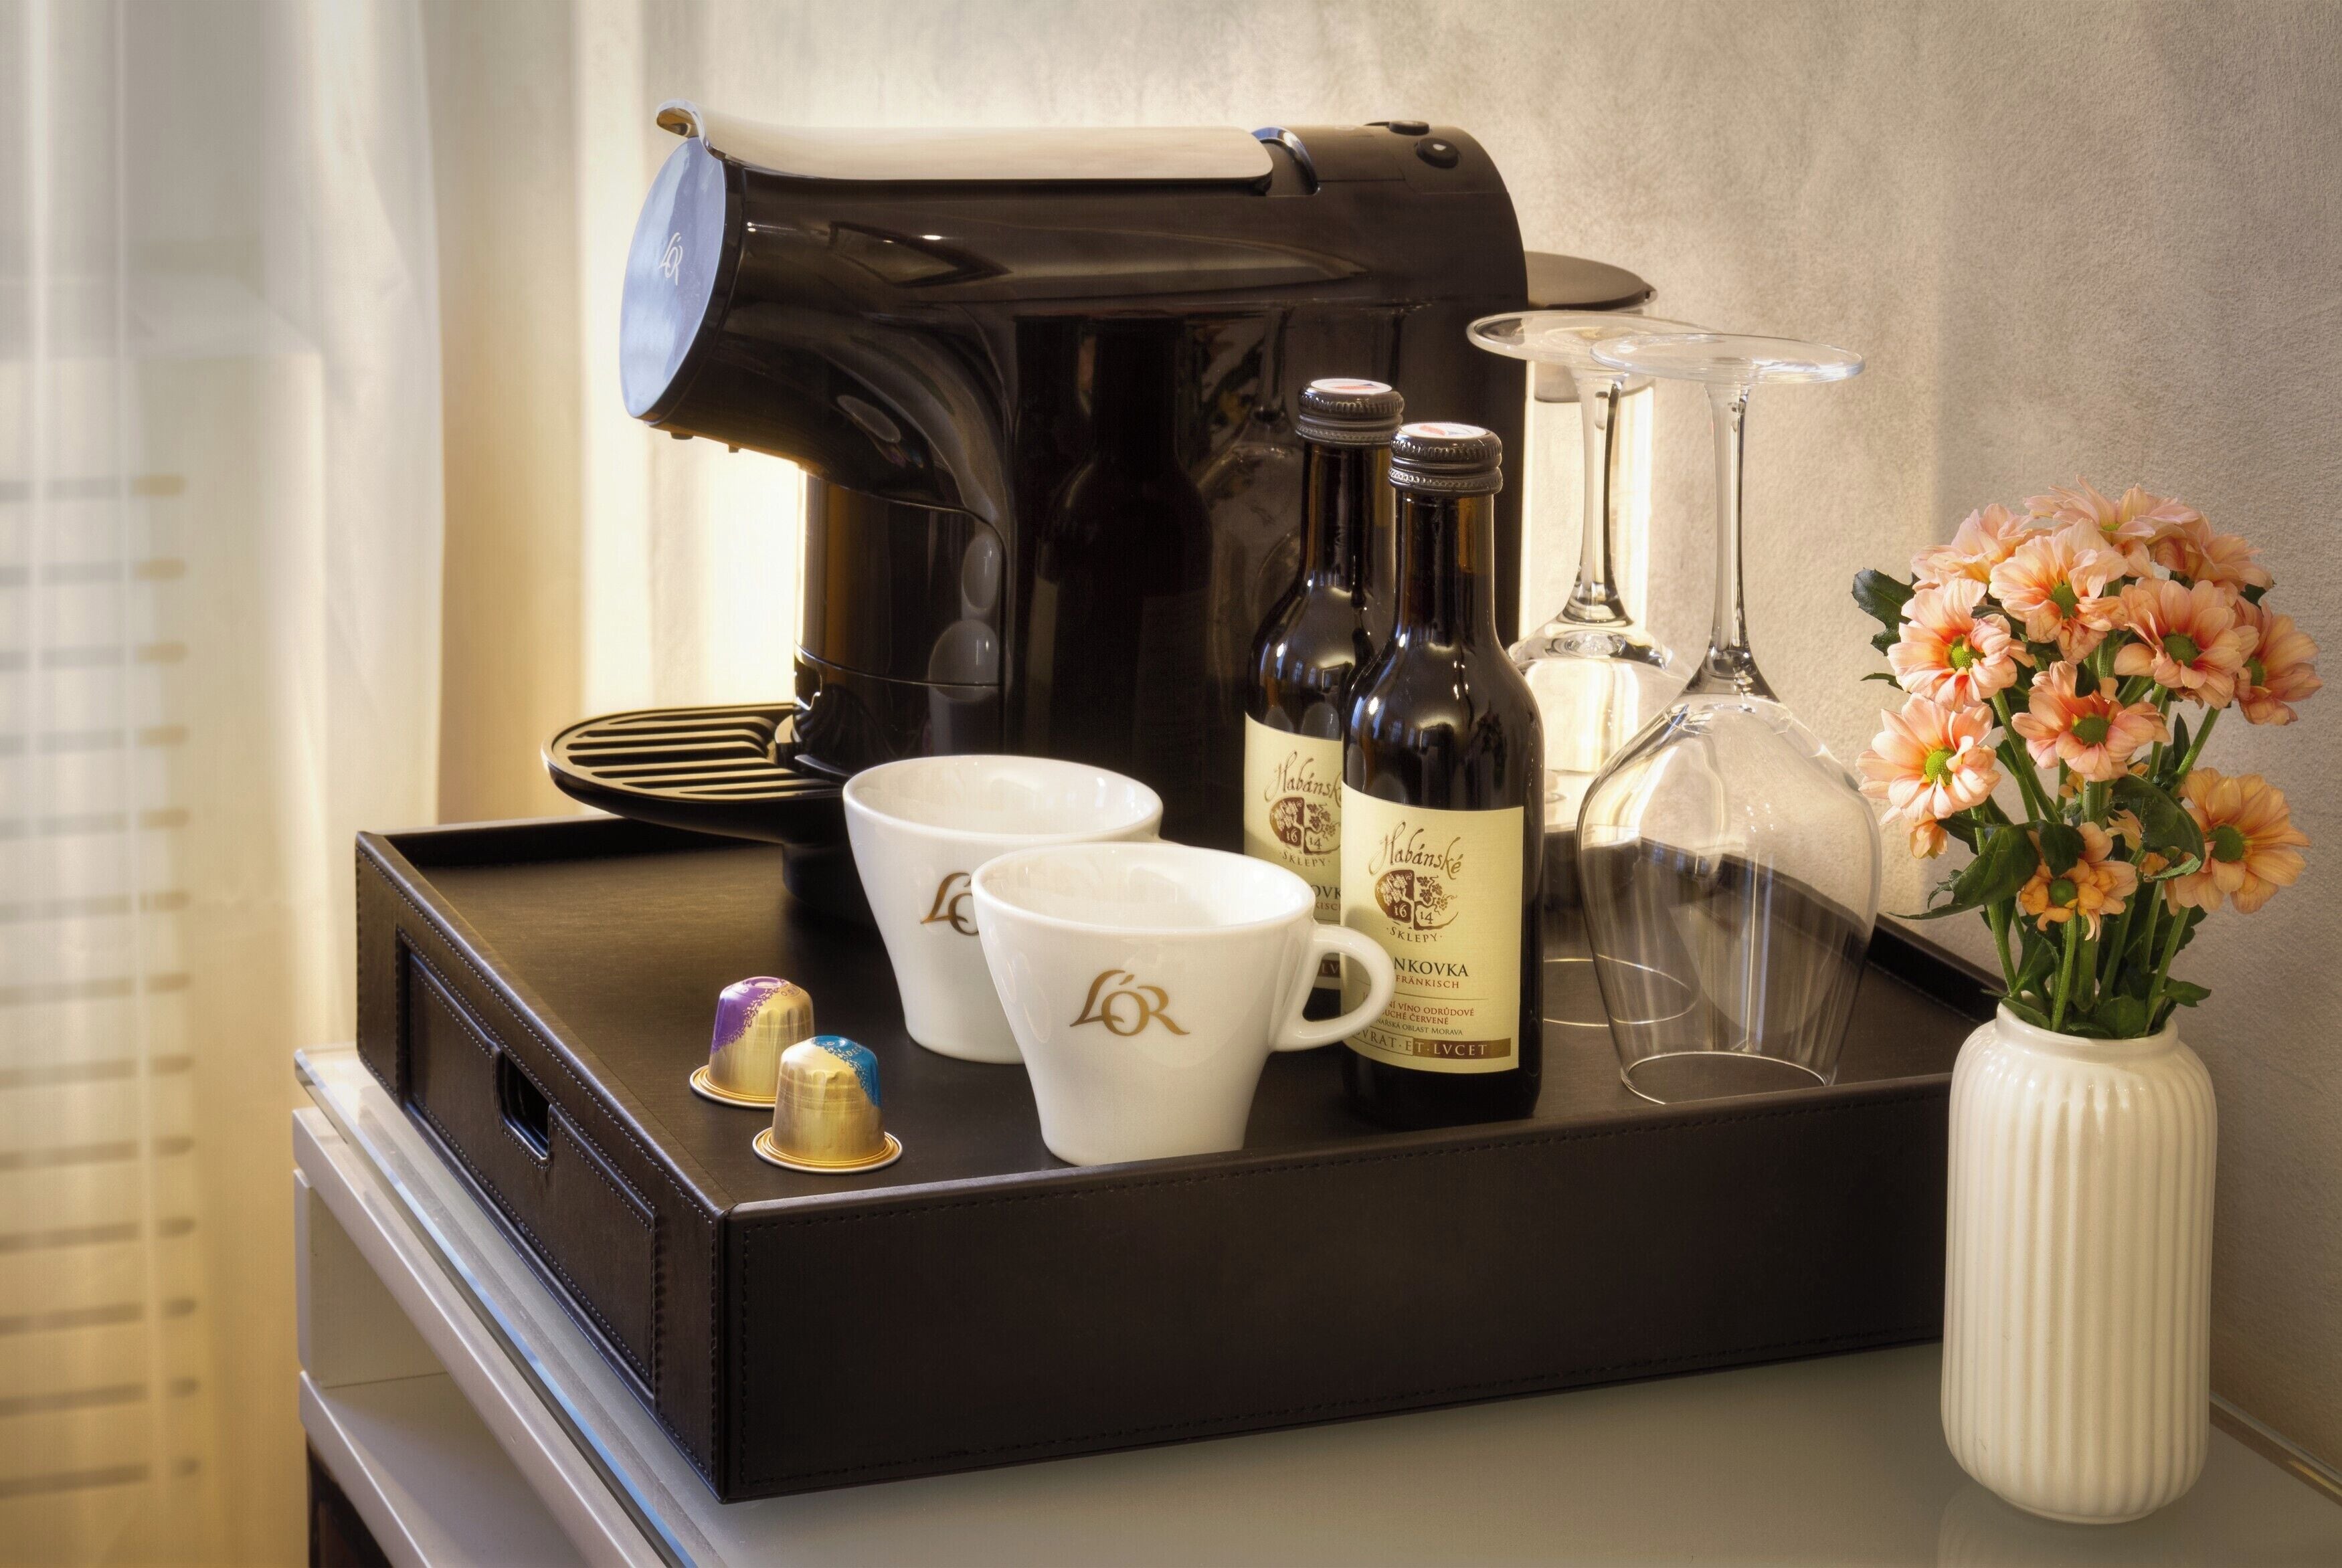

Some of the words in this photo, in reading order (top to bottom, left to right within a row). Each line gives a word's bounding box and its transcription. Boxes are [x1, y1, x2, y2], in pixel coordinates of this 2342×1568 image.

[1286, 827, 1298, 843] 16
[1310, 837, 1322, 850] 14
[1282, 851, 1327, 867] SKLEPY
[1368, 821, 1464, 880] Habánské
[1394, 903, 1407, 918] 16
[1420, 911, 1434, 924] 14
[1390, 926, 1438, 943] SKLEPY
[1394, 957, 1469, 977] NKOVKA
[1395, 975, 1460, 989] FRÄNKISCH
[1070, 969, 1190, 1037] L'OR
[1398, 1002, 1421, 1013] VÍNO
[1423, 1007, 1474, 1017] ODRŮDOVÉ
[1376, 1018, 1401, 1030] NAŘSKÁ
[1402, 1023, 1429, 1034] OBLAST
[1409, 1013, 1449, 1025] ČERVENÉ
[1356, 1029, 1397, 1048] VRAT
[1433, 1043, 1488, 1056] LVCET
